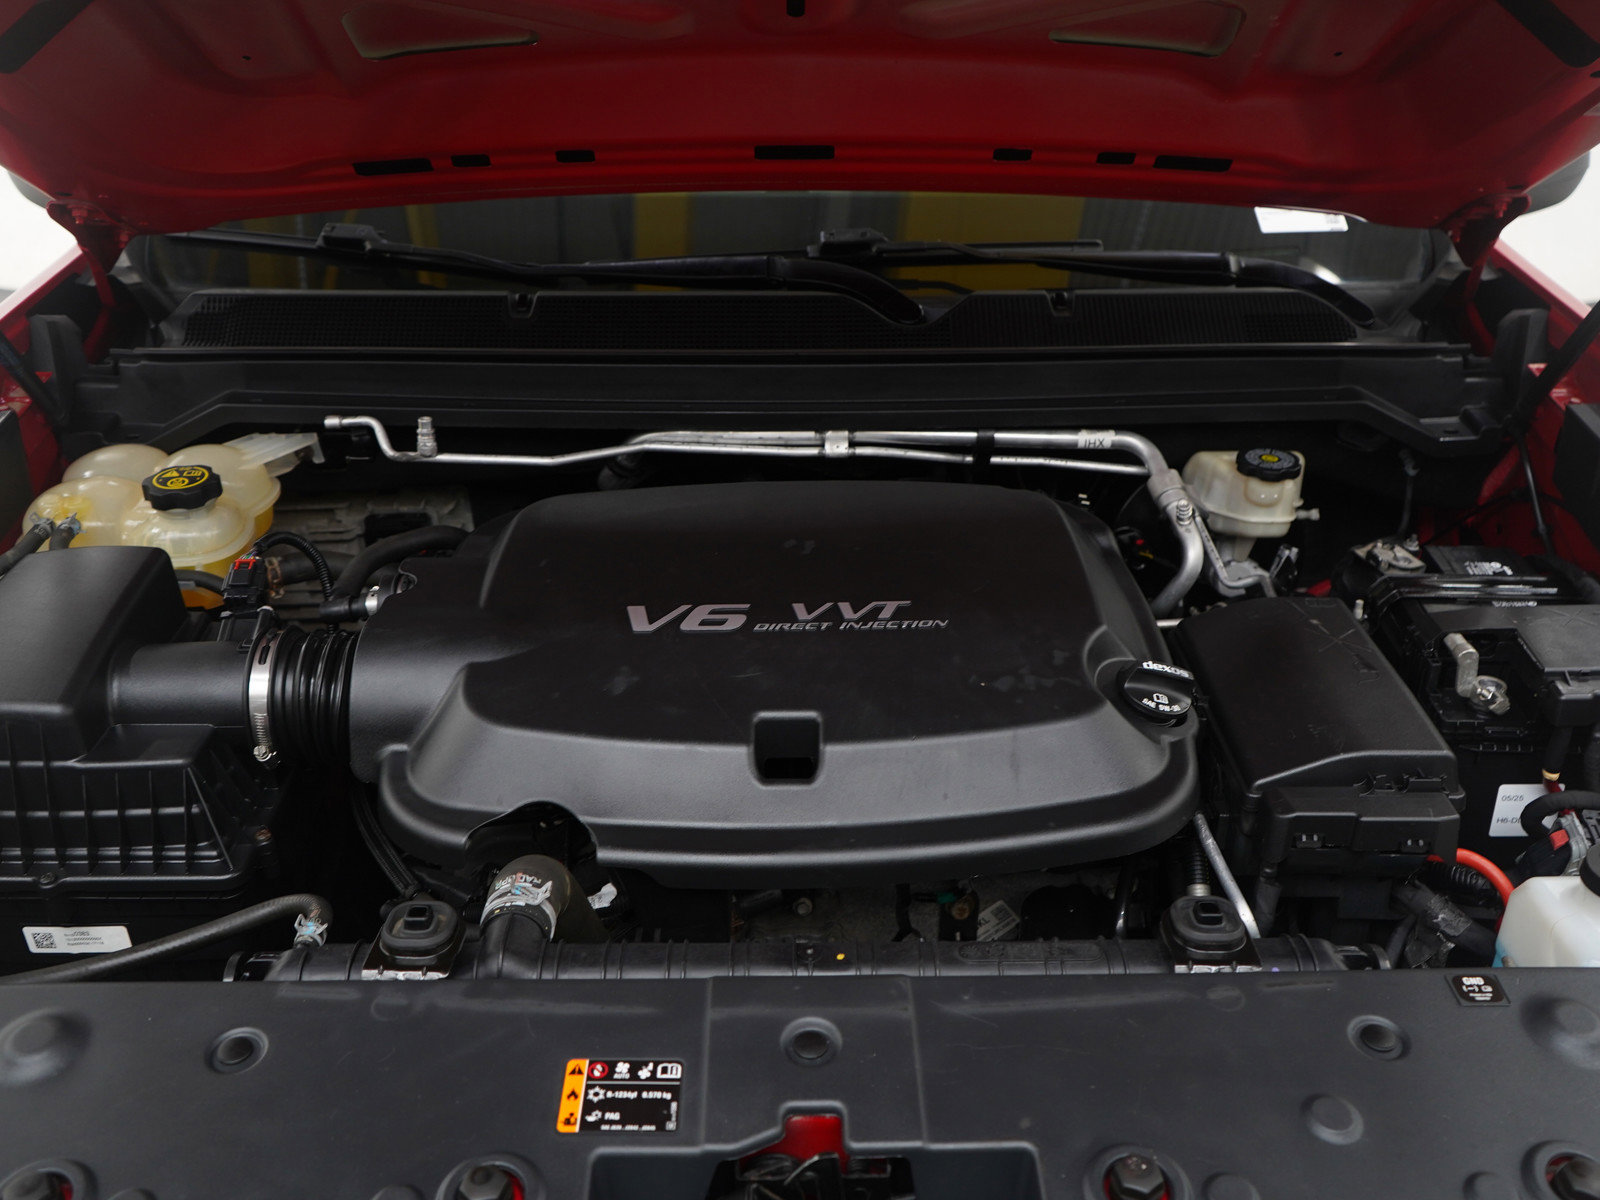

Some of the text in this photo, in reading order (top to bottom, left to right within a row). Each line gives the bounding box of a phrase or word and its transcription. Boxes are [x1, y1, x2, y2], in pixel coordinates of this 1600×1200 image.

[1084, 438, 1105, 449] IHX
[626, 600, 912, 634] V6 VVT
[752, 618, 950, 633] DIRECT INJECTION
[1142, 660, 1189, 678] dexos
[1141, 698, 1157, 709] SAE
[1501, 794, 1524, 802] 05/25
